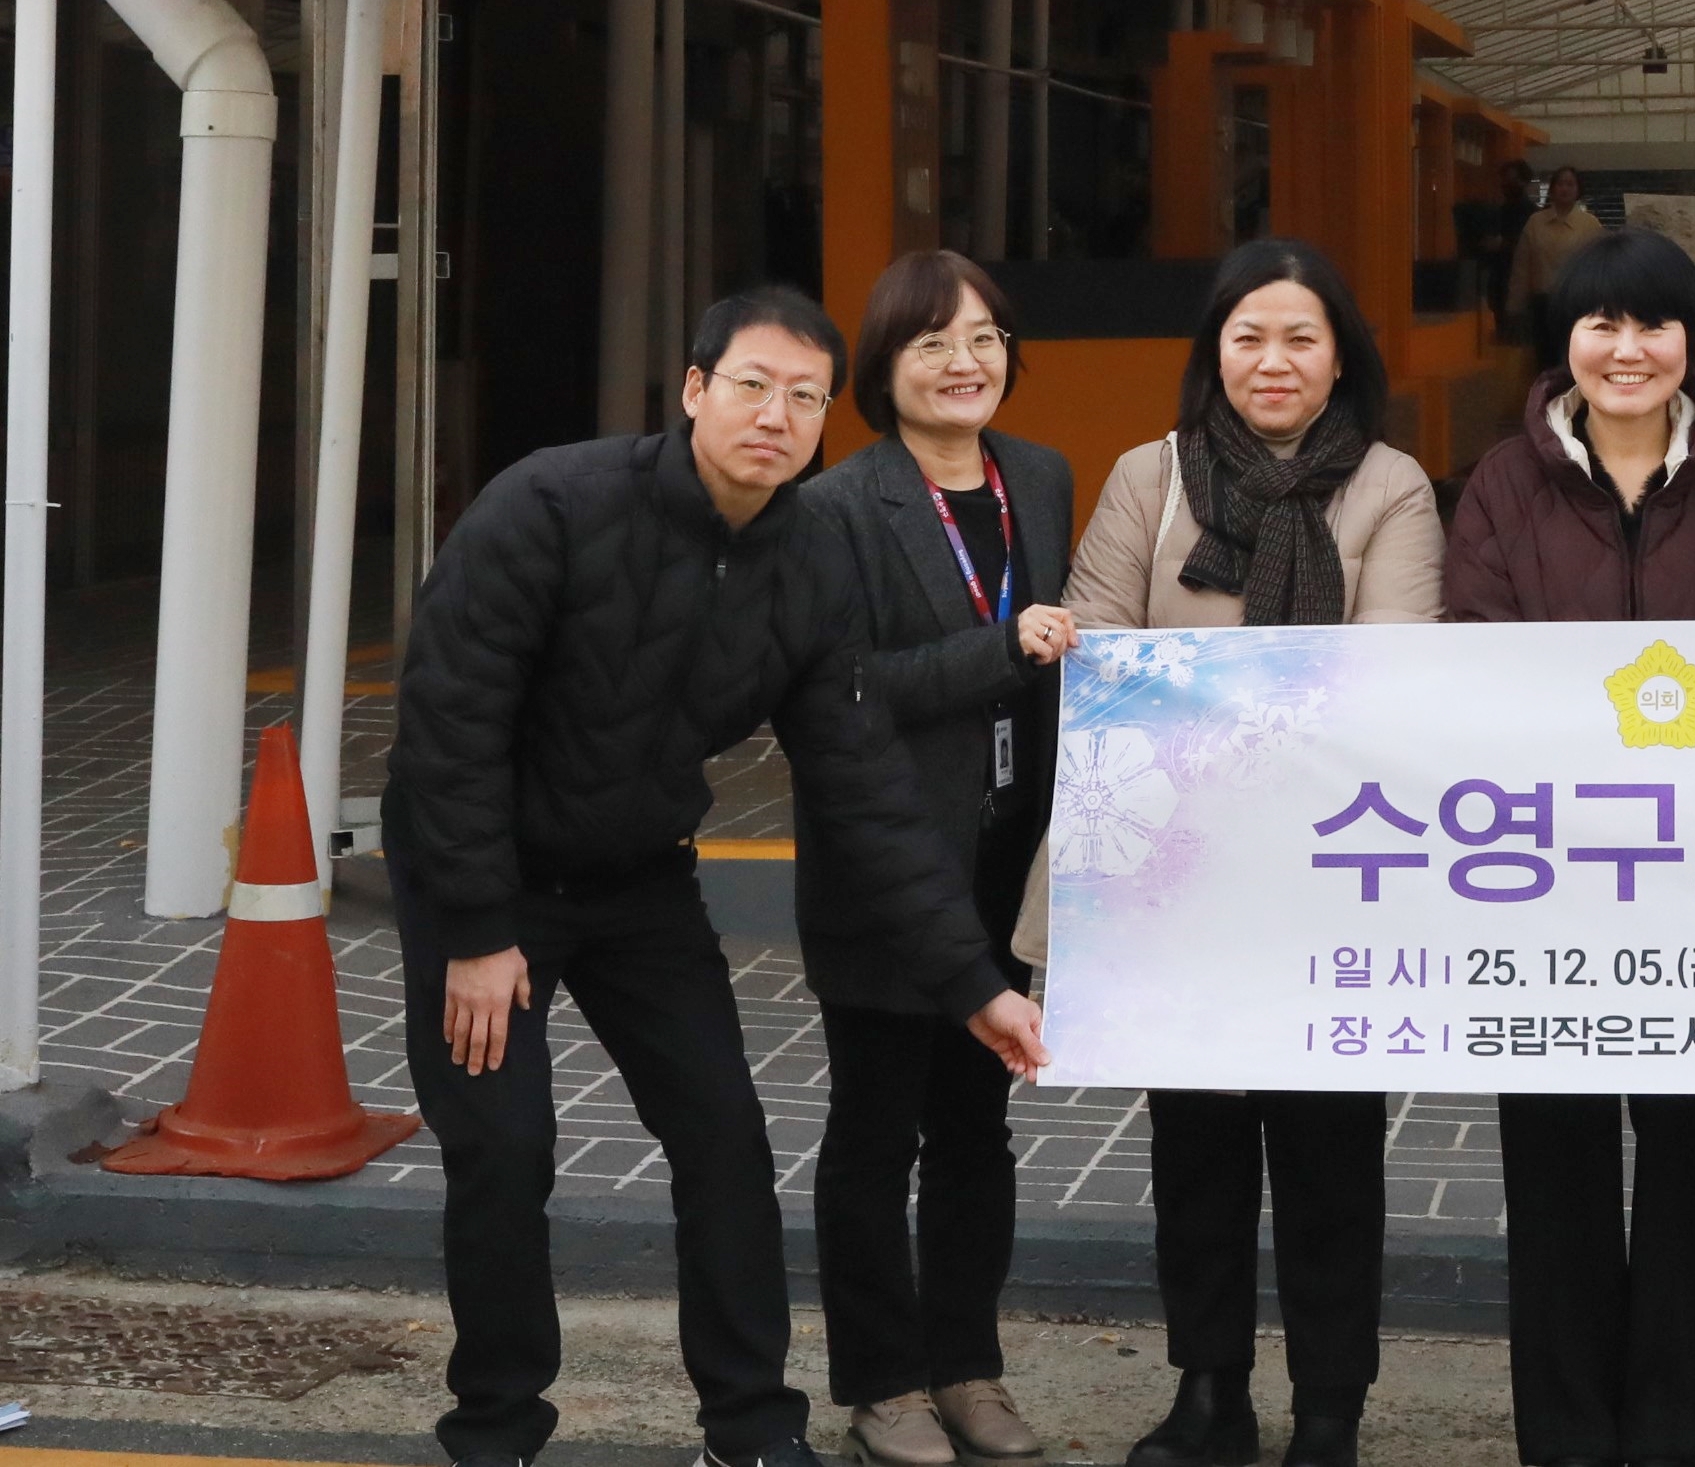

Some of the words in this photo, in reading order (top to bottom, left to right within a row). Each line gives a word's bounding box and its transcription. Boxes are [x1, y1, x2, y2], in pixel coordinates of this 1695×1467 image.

[1640, 689, 1678, 710] 의회
[1467, 948, 1527, 987] 25.
[1543, 949, 1598, 987] 12.
